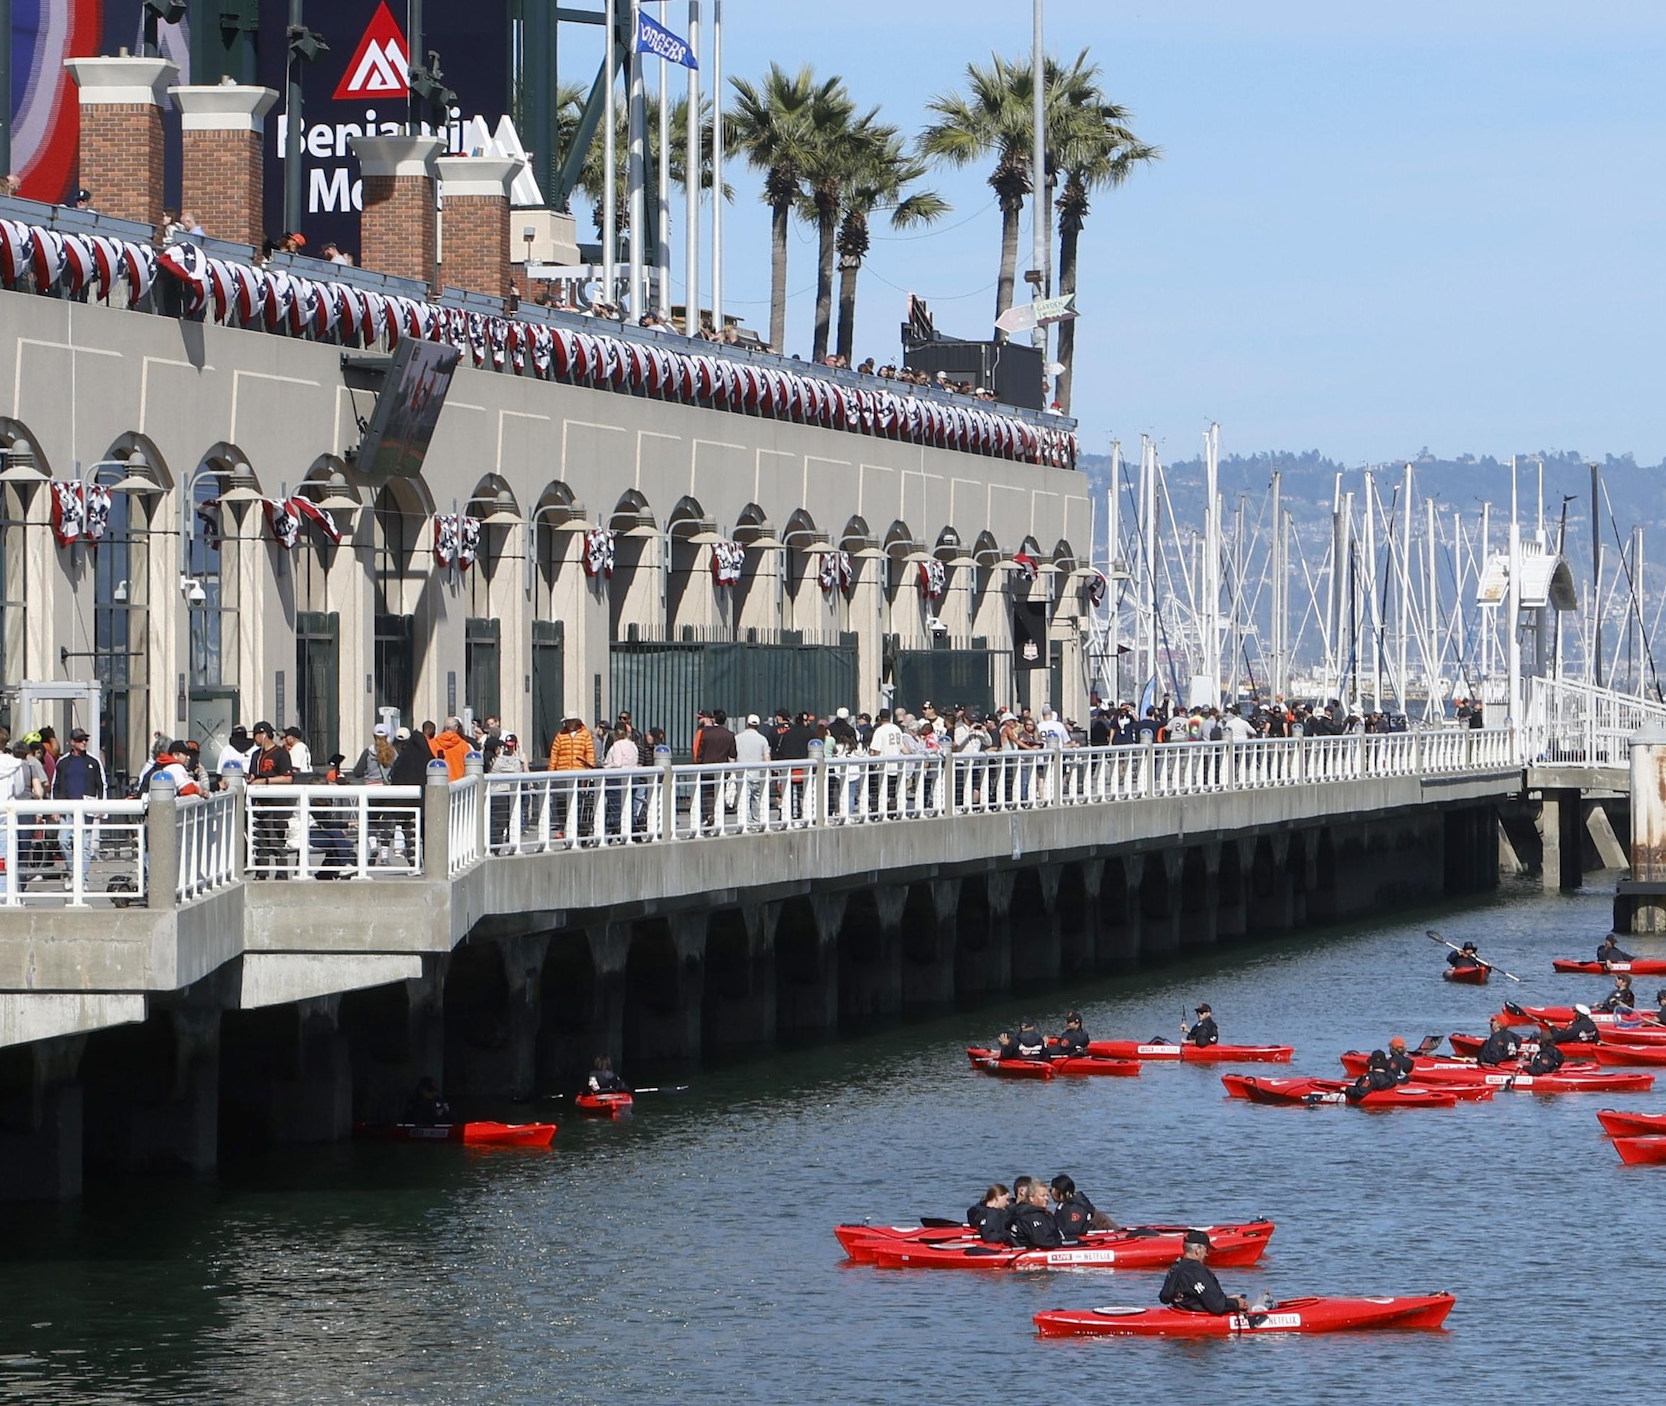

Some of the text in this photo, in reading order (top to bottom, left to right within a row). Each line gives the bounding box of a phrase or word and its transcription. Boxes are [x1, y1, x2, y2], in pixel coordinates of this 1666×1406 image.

[1055, 1253, 1072, 1261] LIVE
[1083, 1250, 1111, 1261] NETFLIX
[1268, 1314, 1297, 1326] NETFLIX
